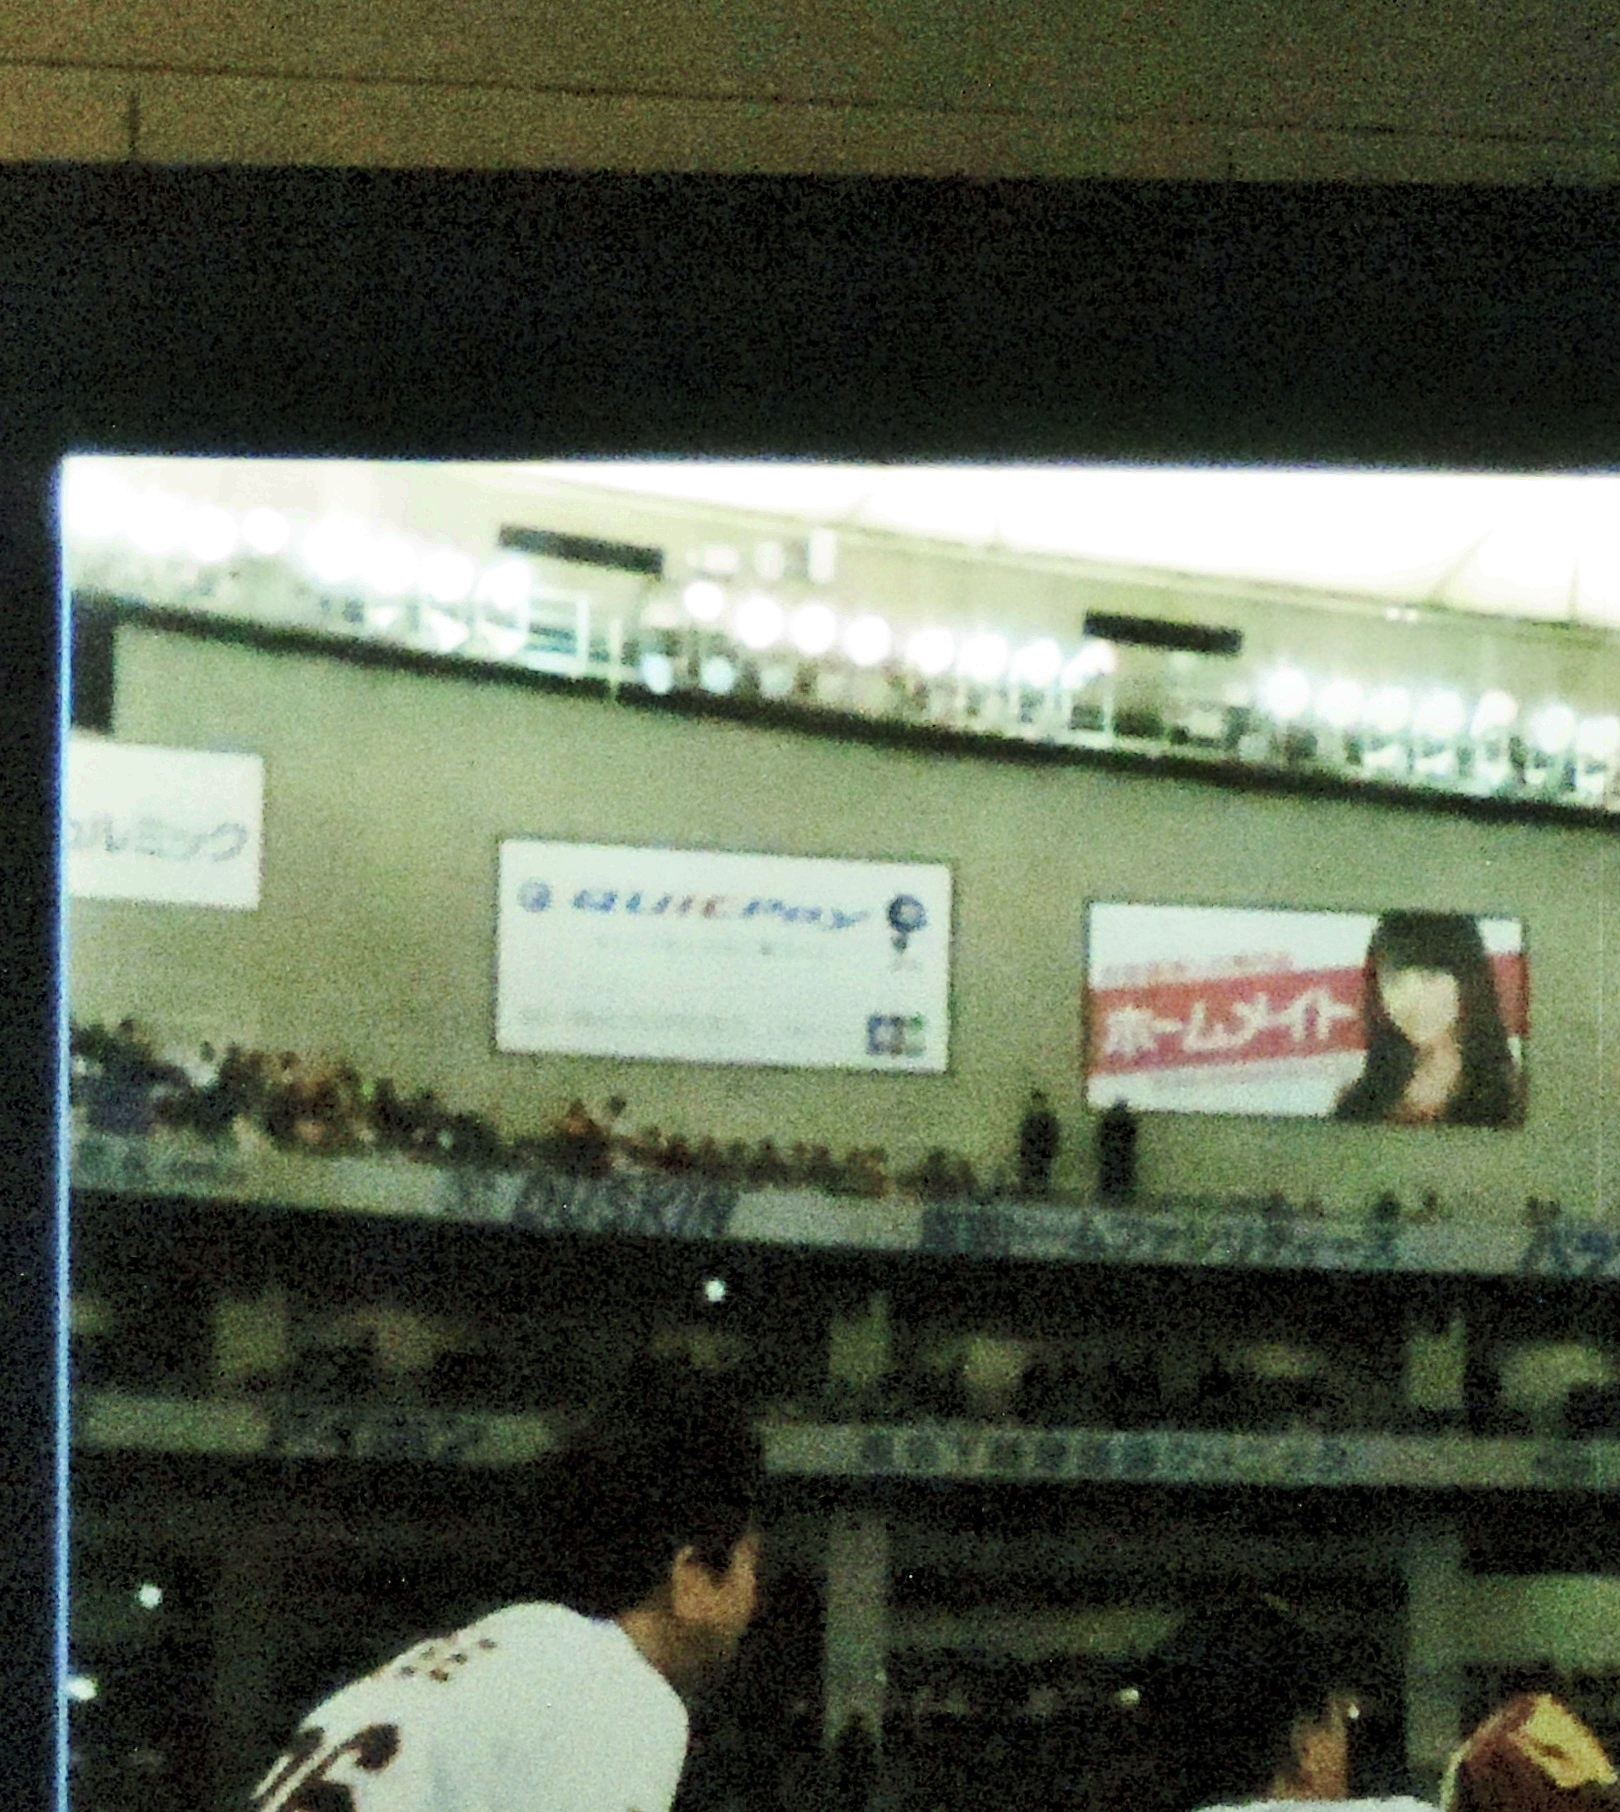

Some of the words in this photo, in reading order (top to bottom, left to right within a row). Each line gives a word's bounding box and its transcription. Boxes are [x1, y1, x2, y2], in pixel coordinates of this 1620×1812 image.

[1105, 988, 1358, 1056] ホームメイト
